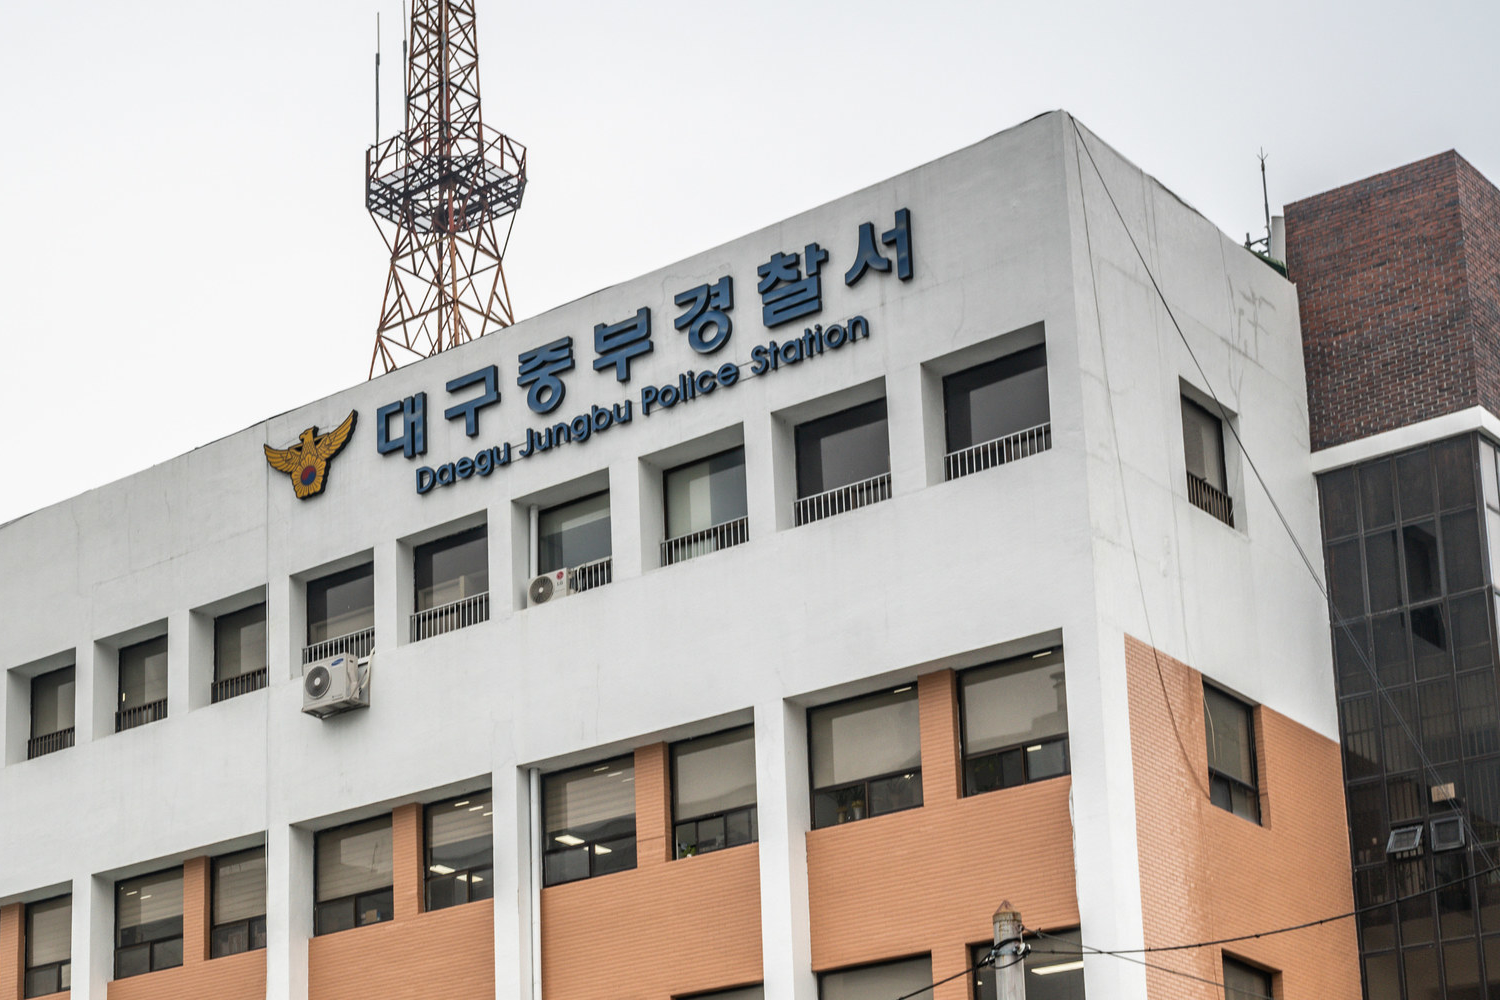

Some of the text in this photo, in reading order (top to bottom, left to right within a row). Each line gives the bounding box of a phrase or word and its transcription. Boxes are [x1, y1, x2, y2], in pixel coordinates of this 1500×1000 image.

[377, 207, 914, 459] 대구중부경찰서
[414, 314, 870, 495] Daegu Jungbu Police Station
